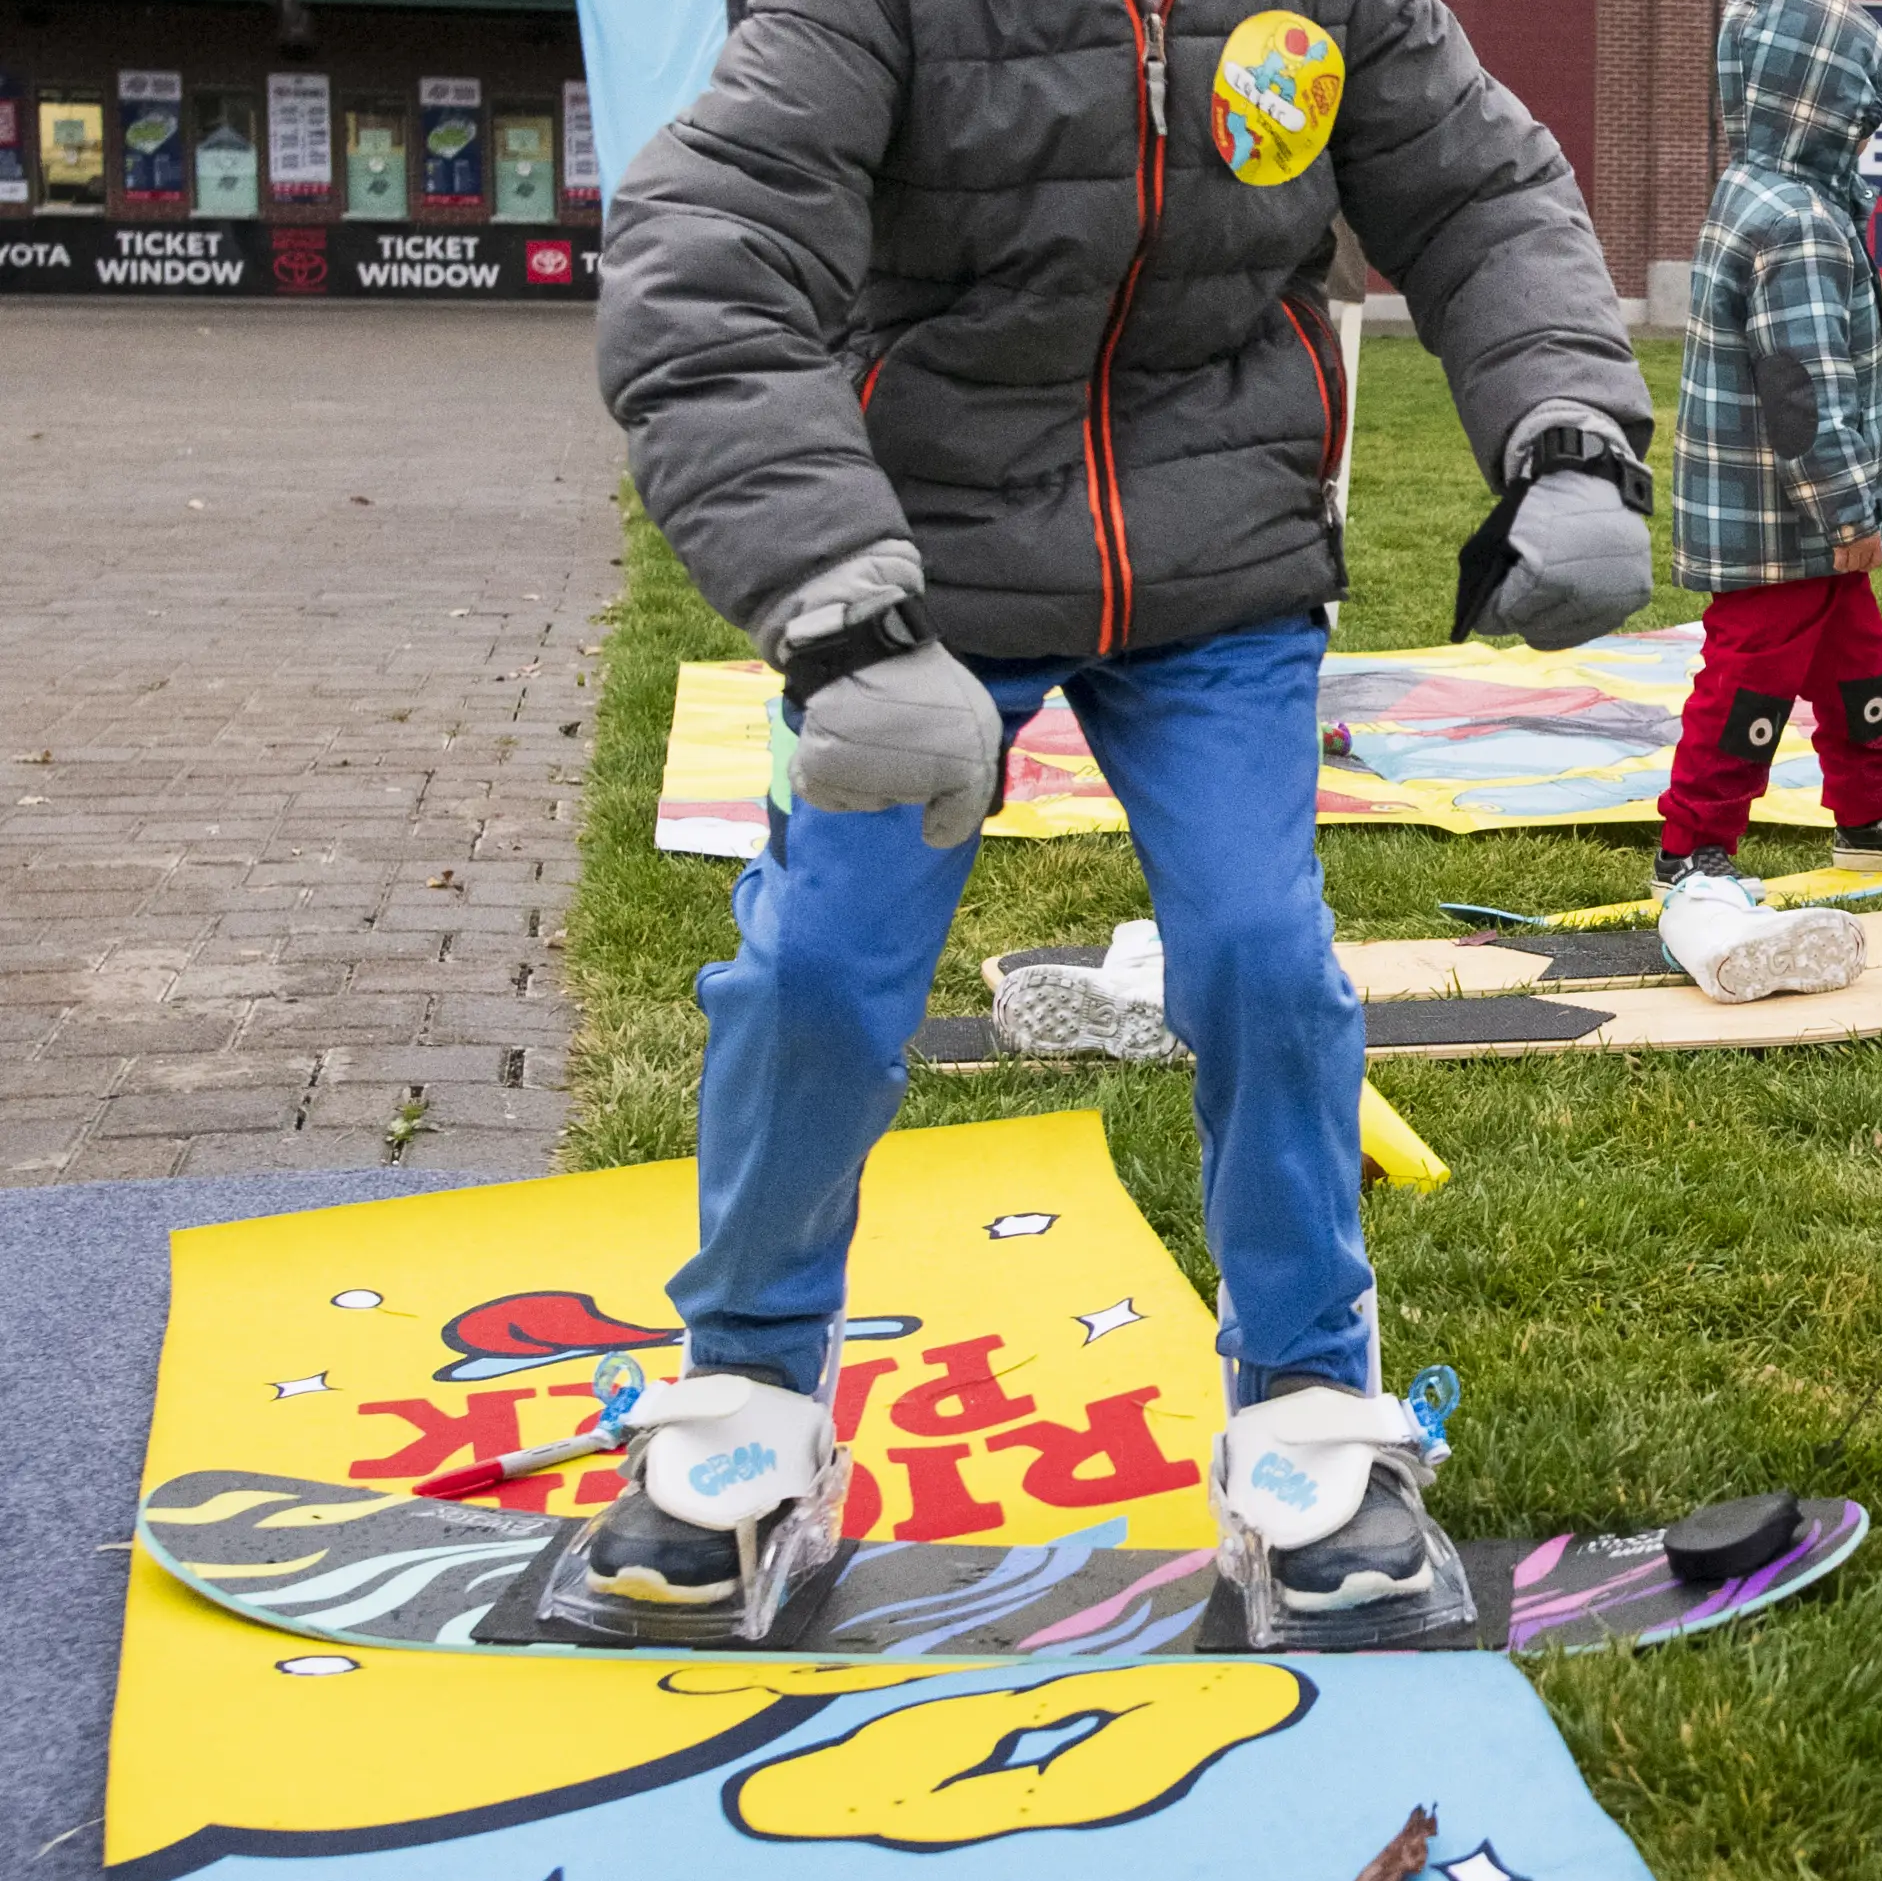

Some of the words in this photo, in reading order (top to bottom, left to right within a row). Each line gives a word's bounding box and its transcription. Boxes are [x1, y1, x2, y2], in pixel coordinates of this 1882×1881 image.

[116, 230, 223, 258] TICKET
[377, 235, 480, 261] TICKET
[97, 257, 244, 287] WINDOW
[357, 261, 500, 289] WINDOW
